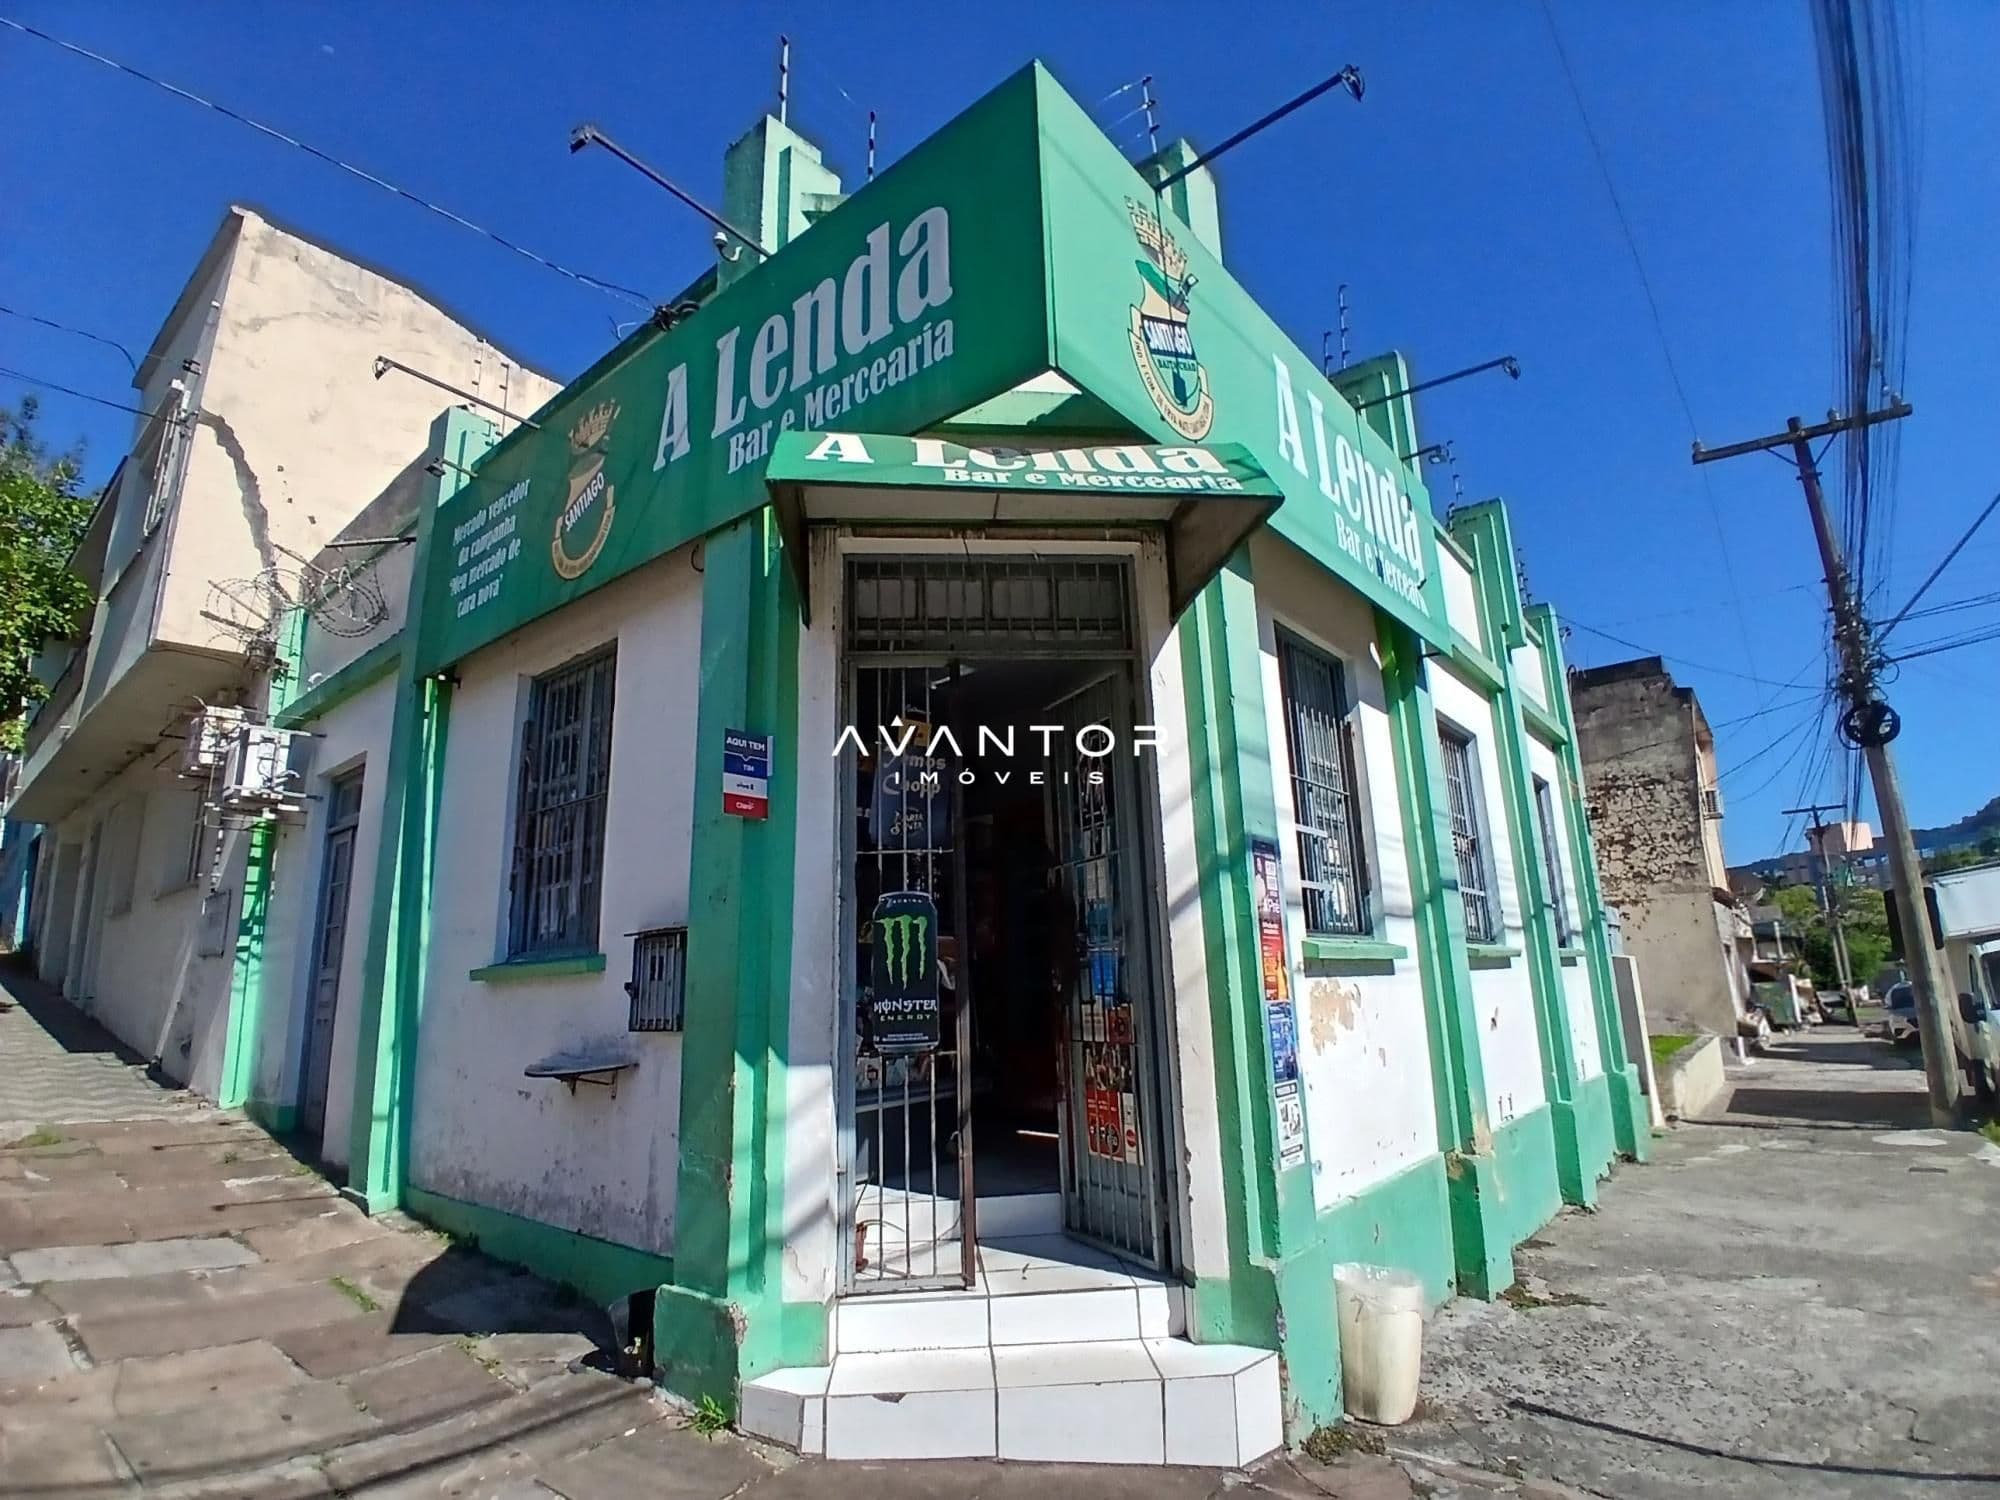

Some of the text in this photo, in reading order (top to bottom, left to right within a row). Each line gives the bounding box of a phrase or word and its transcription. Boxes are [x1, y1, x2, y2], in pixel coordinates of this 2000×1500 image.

[653, 206, 953, 472] A Lenda
[728, 318, 954, 474] Bar e Mercearia
[806, 433, 1229, 474] A Lenda
[1272, 352, 1425, 585] A Lenda
[944, 469, 1244, 490] Bar e Mercearia
[564, 472, 605, 532] SANTIAGO
[453, 509, 487, 546] Mercado
[1334, 511, 1361, 563] Bar
[1364, 542, 1374, 574] e
[468, 547, 507, 586] mercado
[508, 538, 521, 560] de
[457, 593, 477, 619] cara
[726, 736, 765, 751] AQUI TEM
[874, 999, 937, 1014] MONSTER
